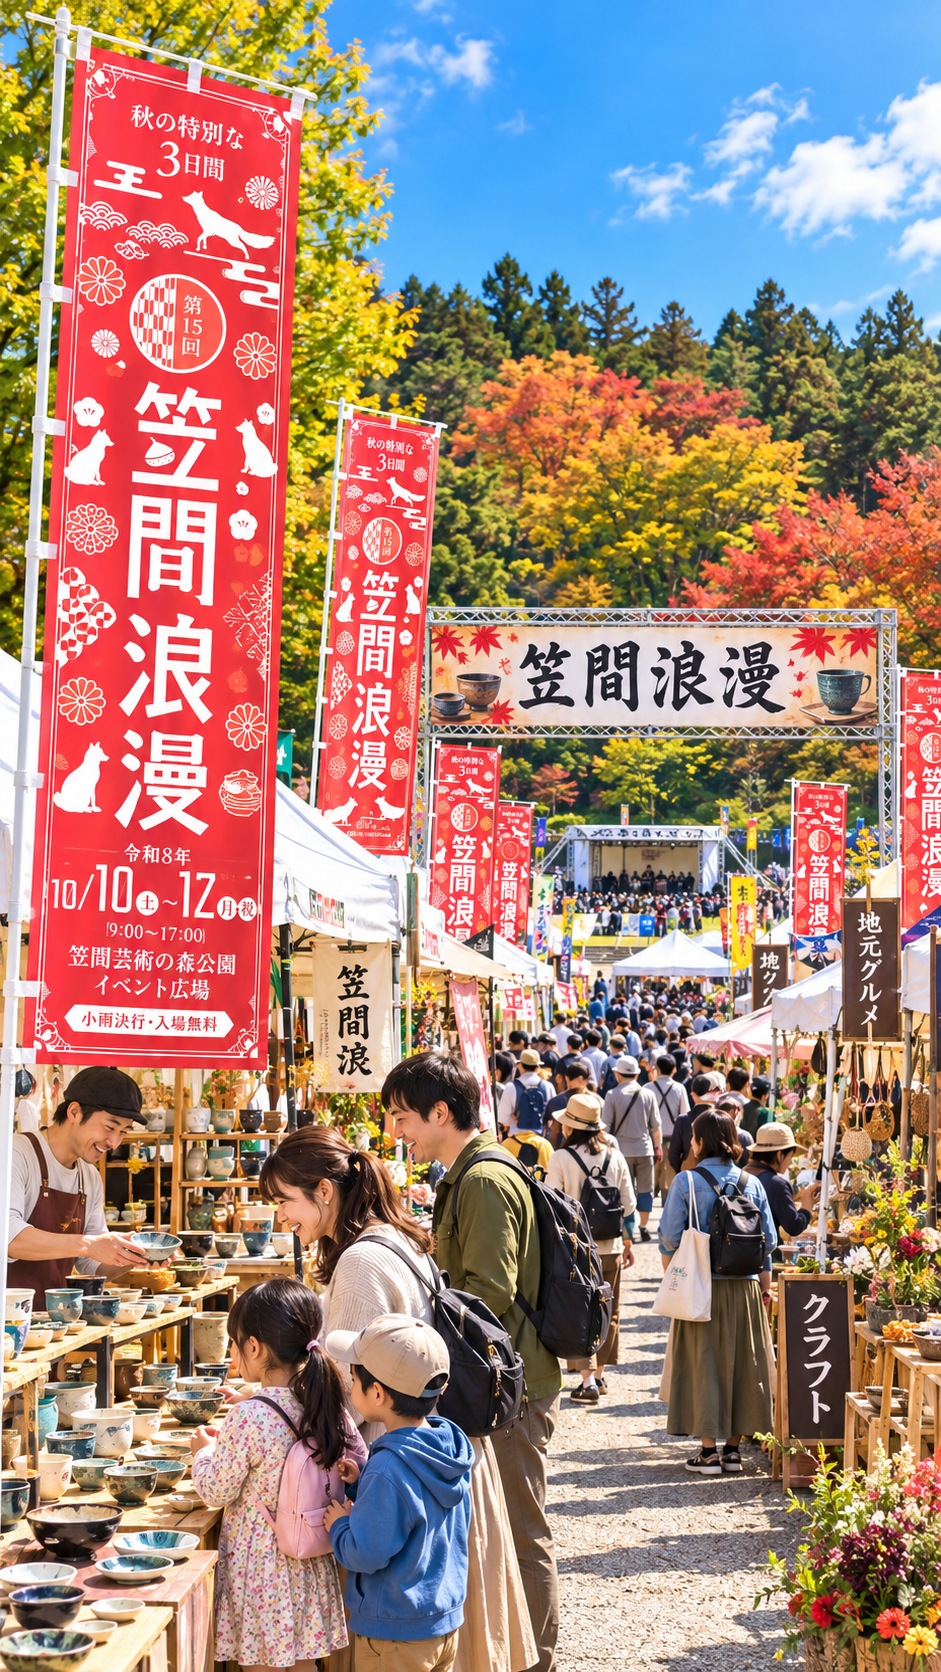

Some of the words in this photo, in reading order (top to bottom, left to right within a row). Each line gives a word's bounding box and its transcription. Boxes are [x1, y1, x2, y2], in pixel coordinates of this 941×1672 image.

[130, 104, 244, 150] 秋の特別な
[156, 141, 225, 182] 3日間
[181, 296, 203, 358] 第15回
[114, 380, 222, 836] 笠間浪漫
[347, 569, 400, 791] 笠間浪漫
[518, 640, 787, 714] 笠間浪漫
[124, 843, 191, 866] 令和8年
[68, 945, 236, 975] 笠間芸術の森公園
[95, 973, 210, 1001] イベント広場
[856, 911, 884, 1026] 地元グルメ
[336, 964, 373, 1076] 笠間浪
[803, 1293, 832, 1425] クラフト
